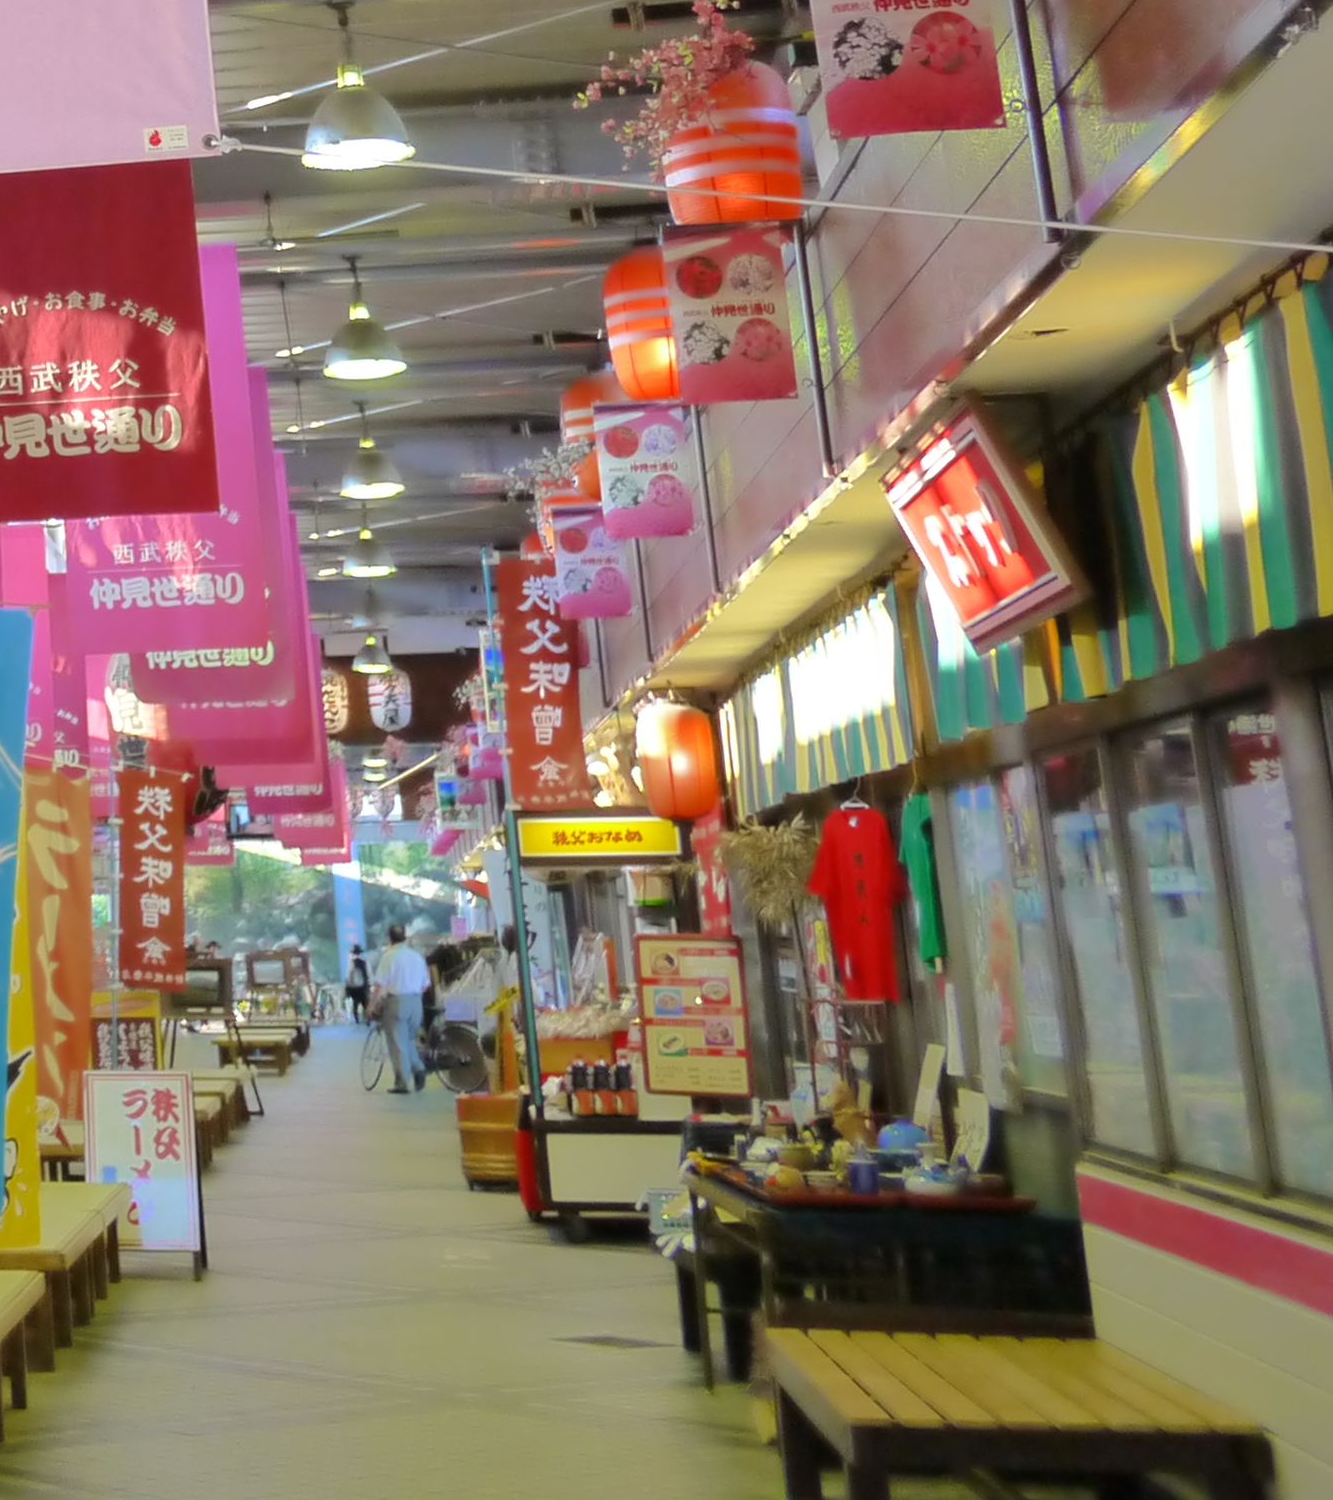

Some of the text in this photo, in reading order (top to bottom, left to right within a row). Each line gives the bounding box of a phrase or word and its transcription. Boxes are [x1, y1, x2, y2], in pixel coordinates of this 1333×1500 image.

[111, 538, 217, 566] 西武秩父
[89, 571, 245, 610] 仲見世通り
